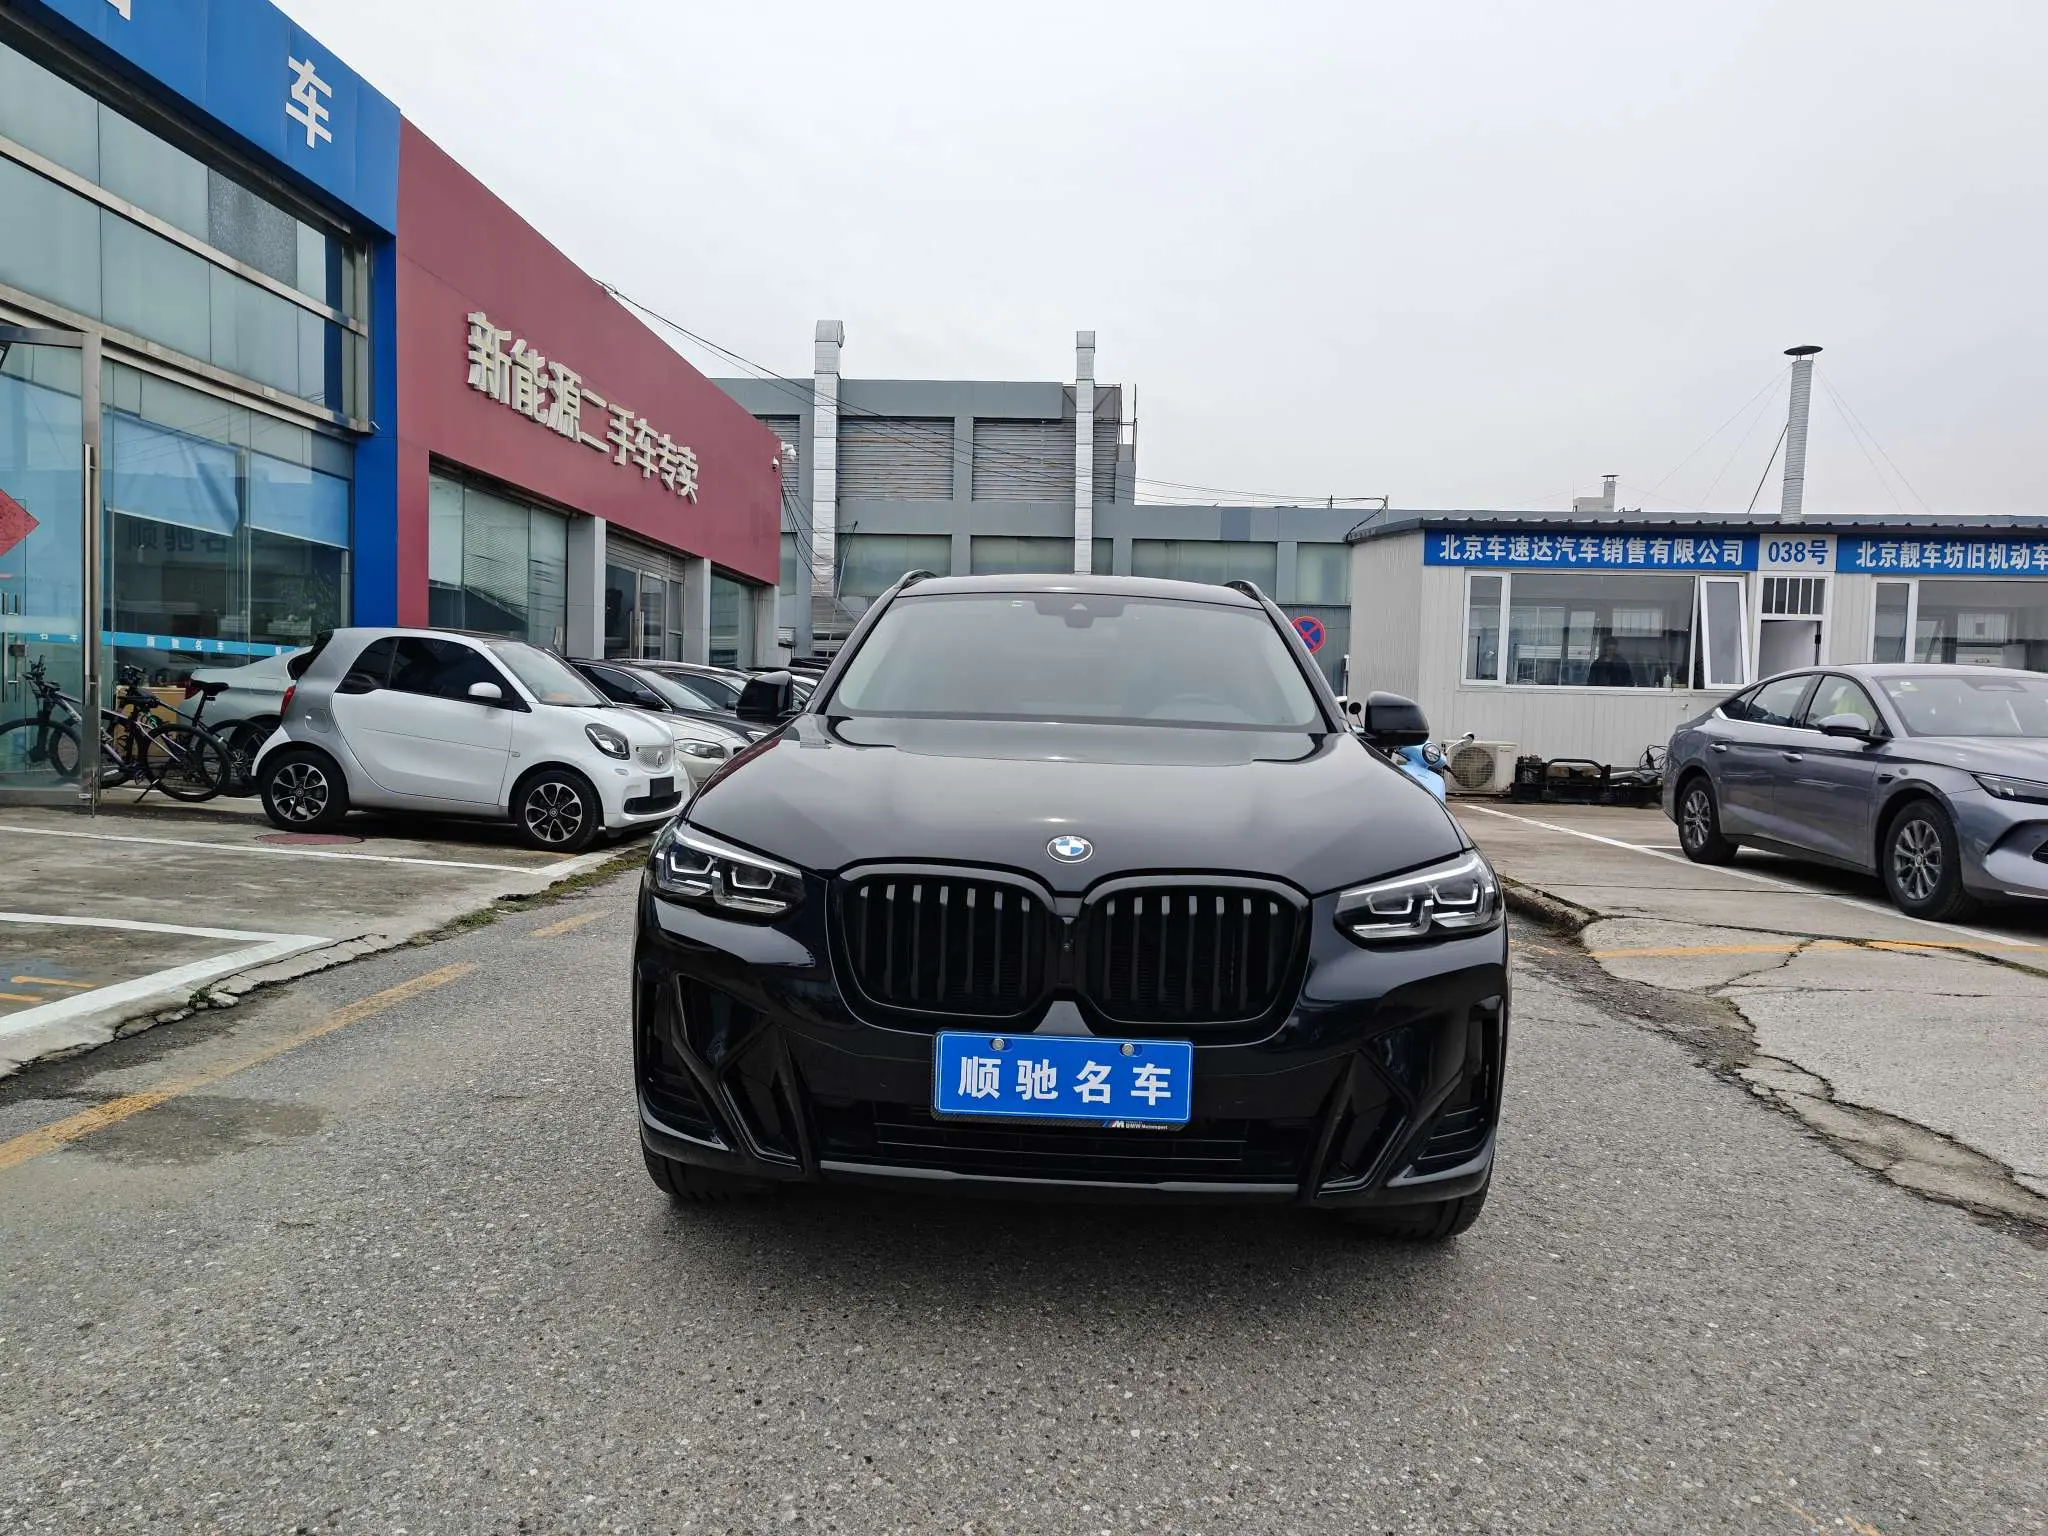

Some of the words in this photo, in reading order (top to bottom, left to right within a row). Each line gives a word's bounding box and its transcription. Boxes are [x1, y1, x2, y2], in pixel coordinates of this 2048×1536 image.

[285, 55, 332, 149] 车
[467, 311, 699, 505] 新能源二手车专卖
[1439, 534, 1744, 566] 北京车速达汽车销售有限公司
[1768, 540, 1830, 565] 038号
[1856, 540, 2048, 571] 北京靓车坊旧机动车
[957, 1055, 1171, 1106] 顺驰名车
